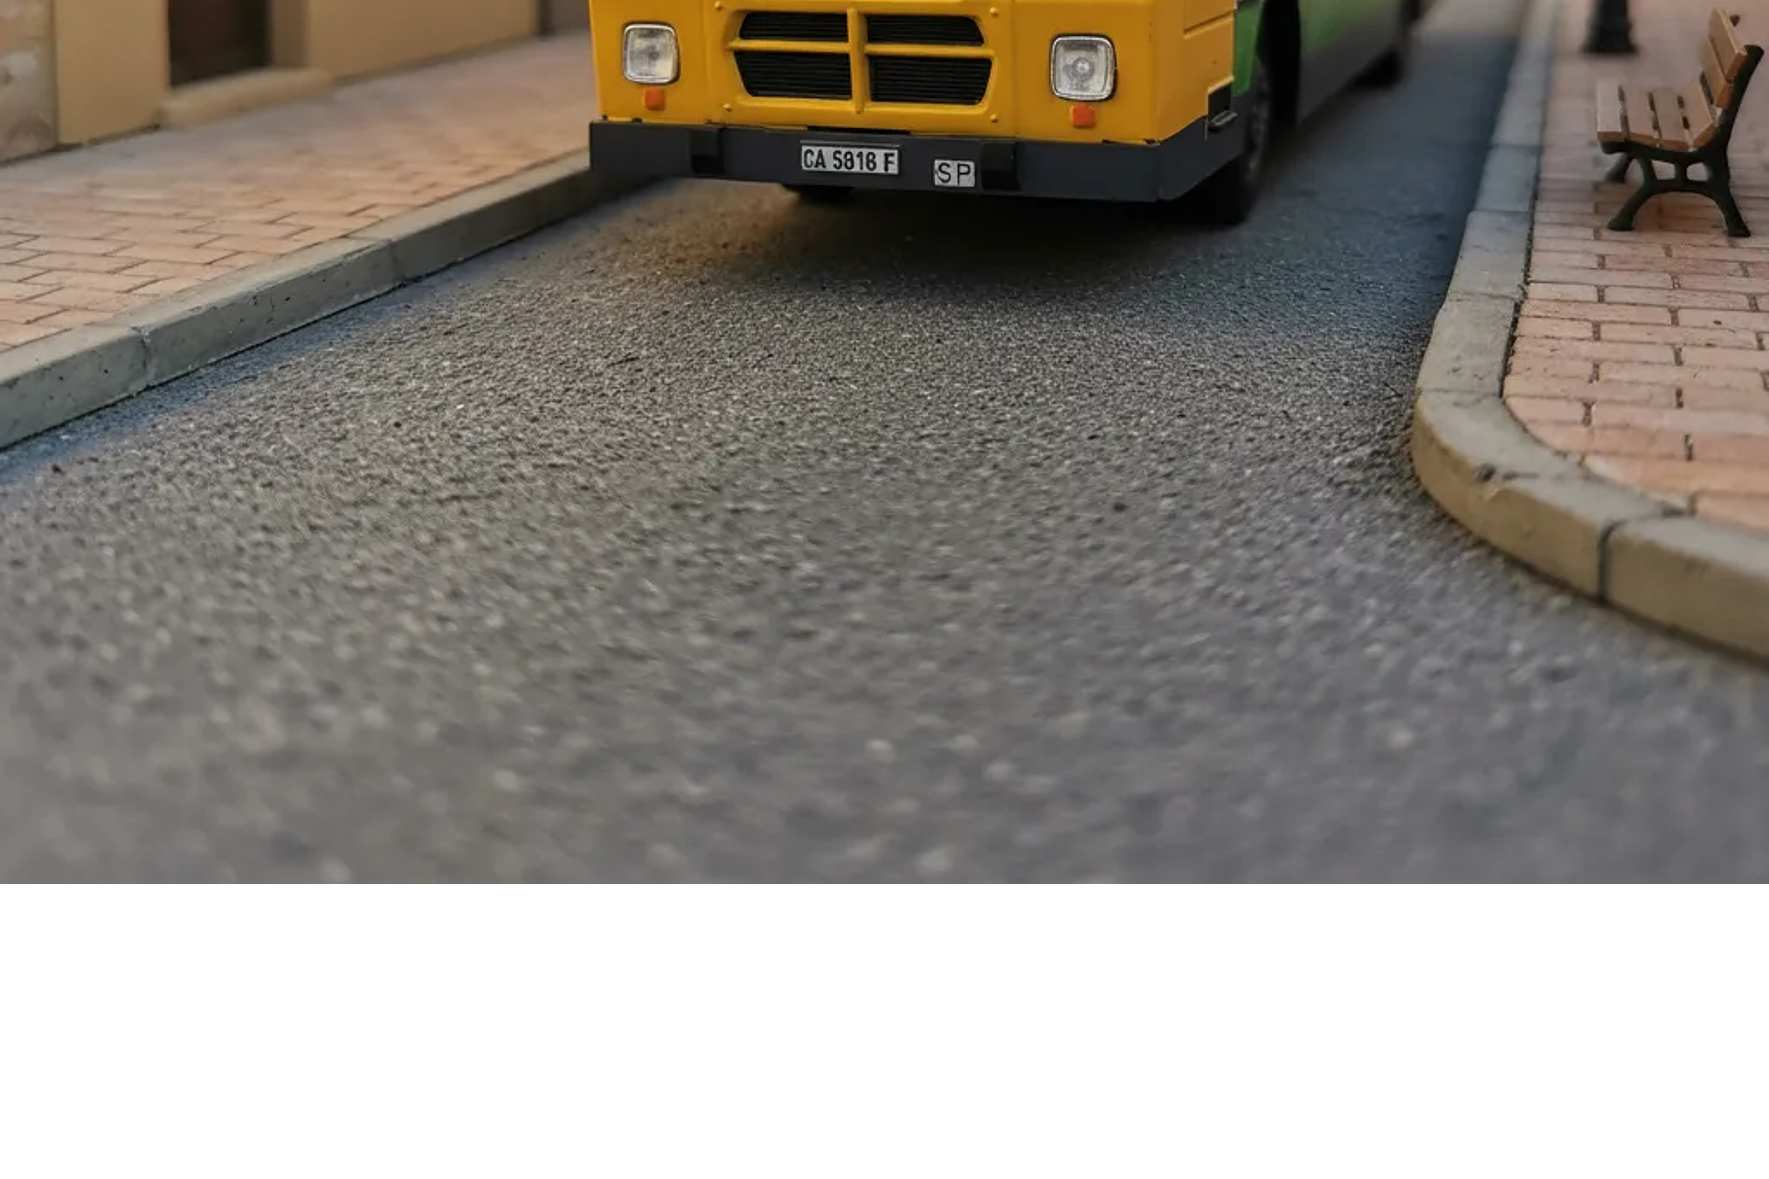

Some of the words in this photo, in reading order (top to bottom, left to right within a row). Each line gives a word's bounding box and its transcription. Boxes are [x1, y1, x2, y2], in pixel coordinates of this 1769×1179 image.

[803, 149, 826, 169] CA
[884, 152, 895, 172] F
[936, 162, 972, 185] SP
